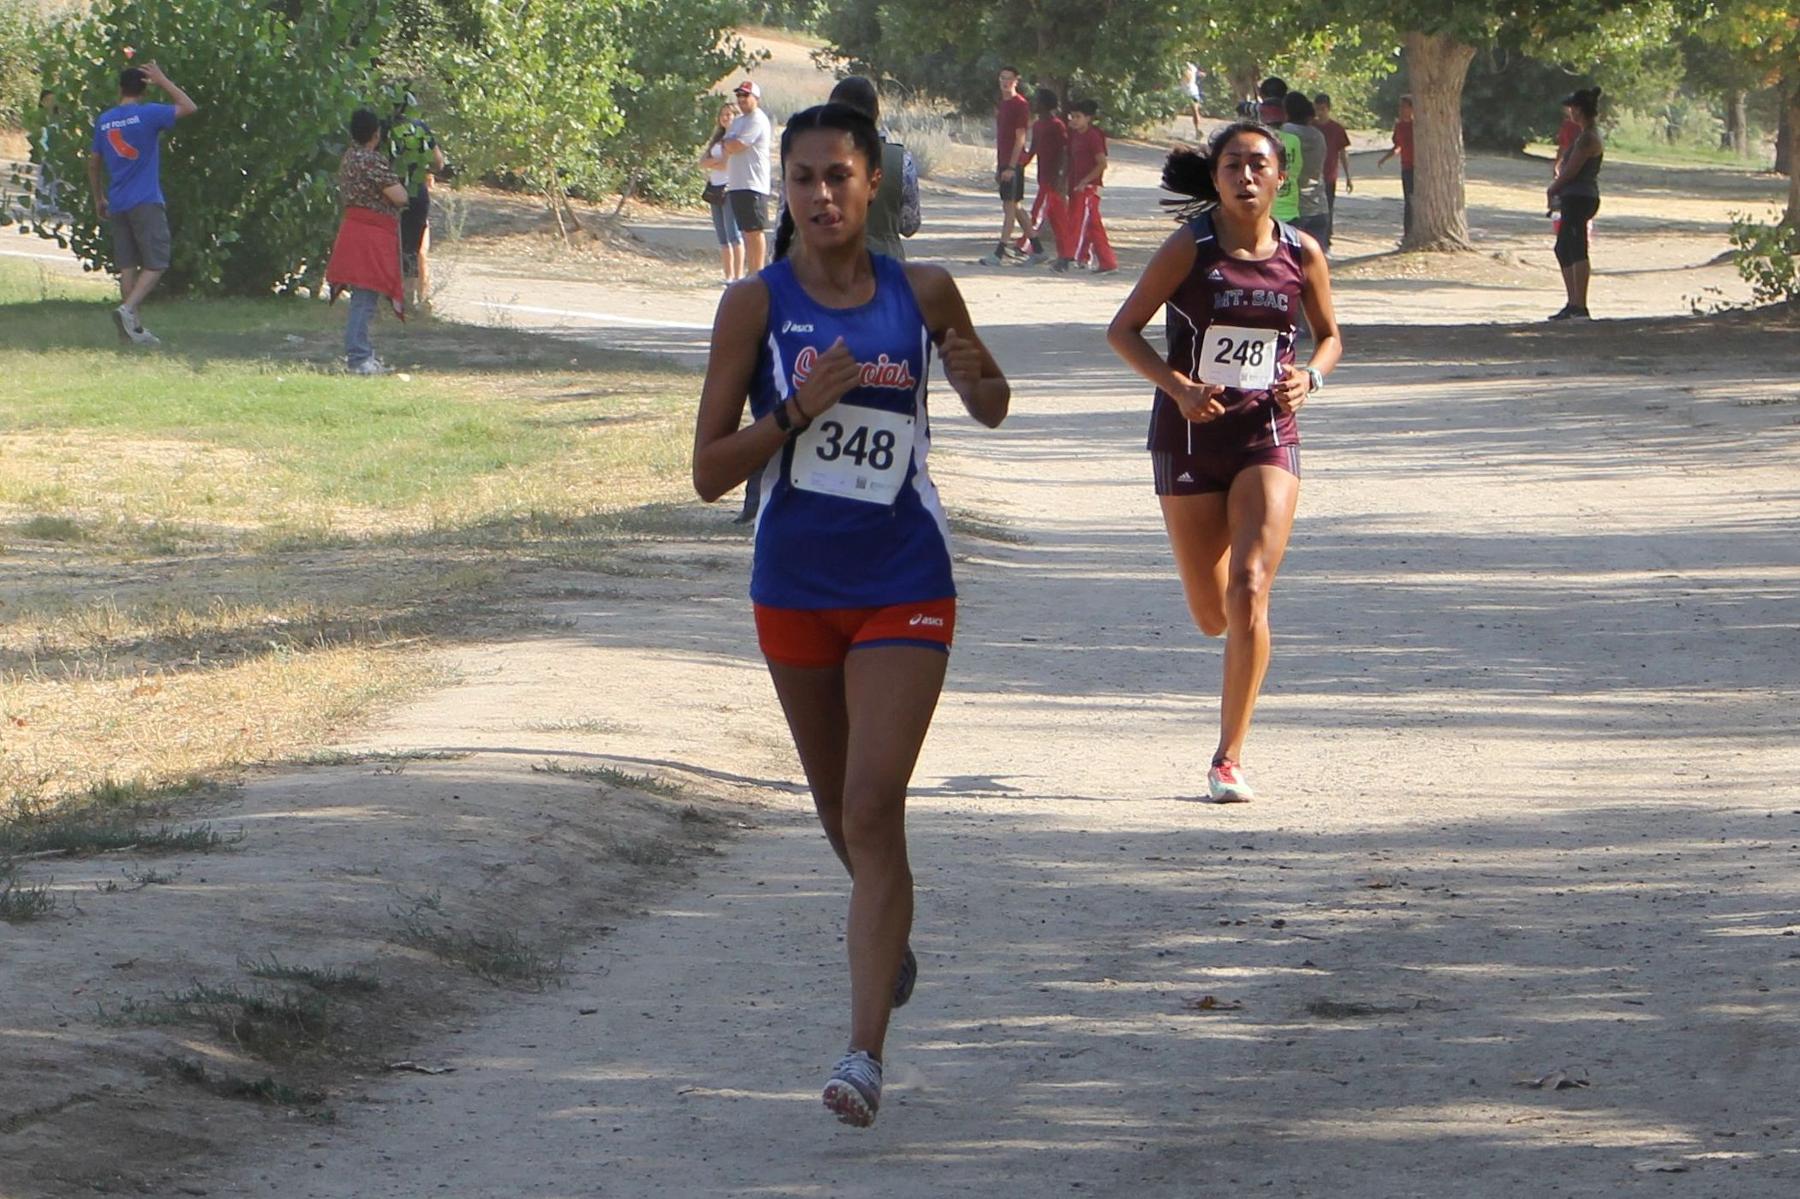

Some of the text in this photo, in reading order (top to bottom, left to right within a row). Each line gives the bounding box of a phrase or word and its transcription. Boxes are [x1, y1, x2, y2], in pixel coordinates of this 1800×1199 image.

[1252, 289, 1288, 312] SAC
[1214, 337, 1265, 367] 248
[816, 421, 896, 471] 348
